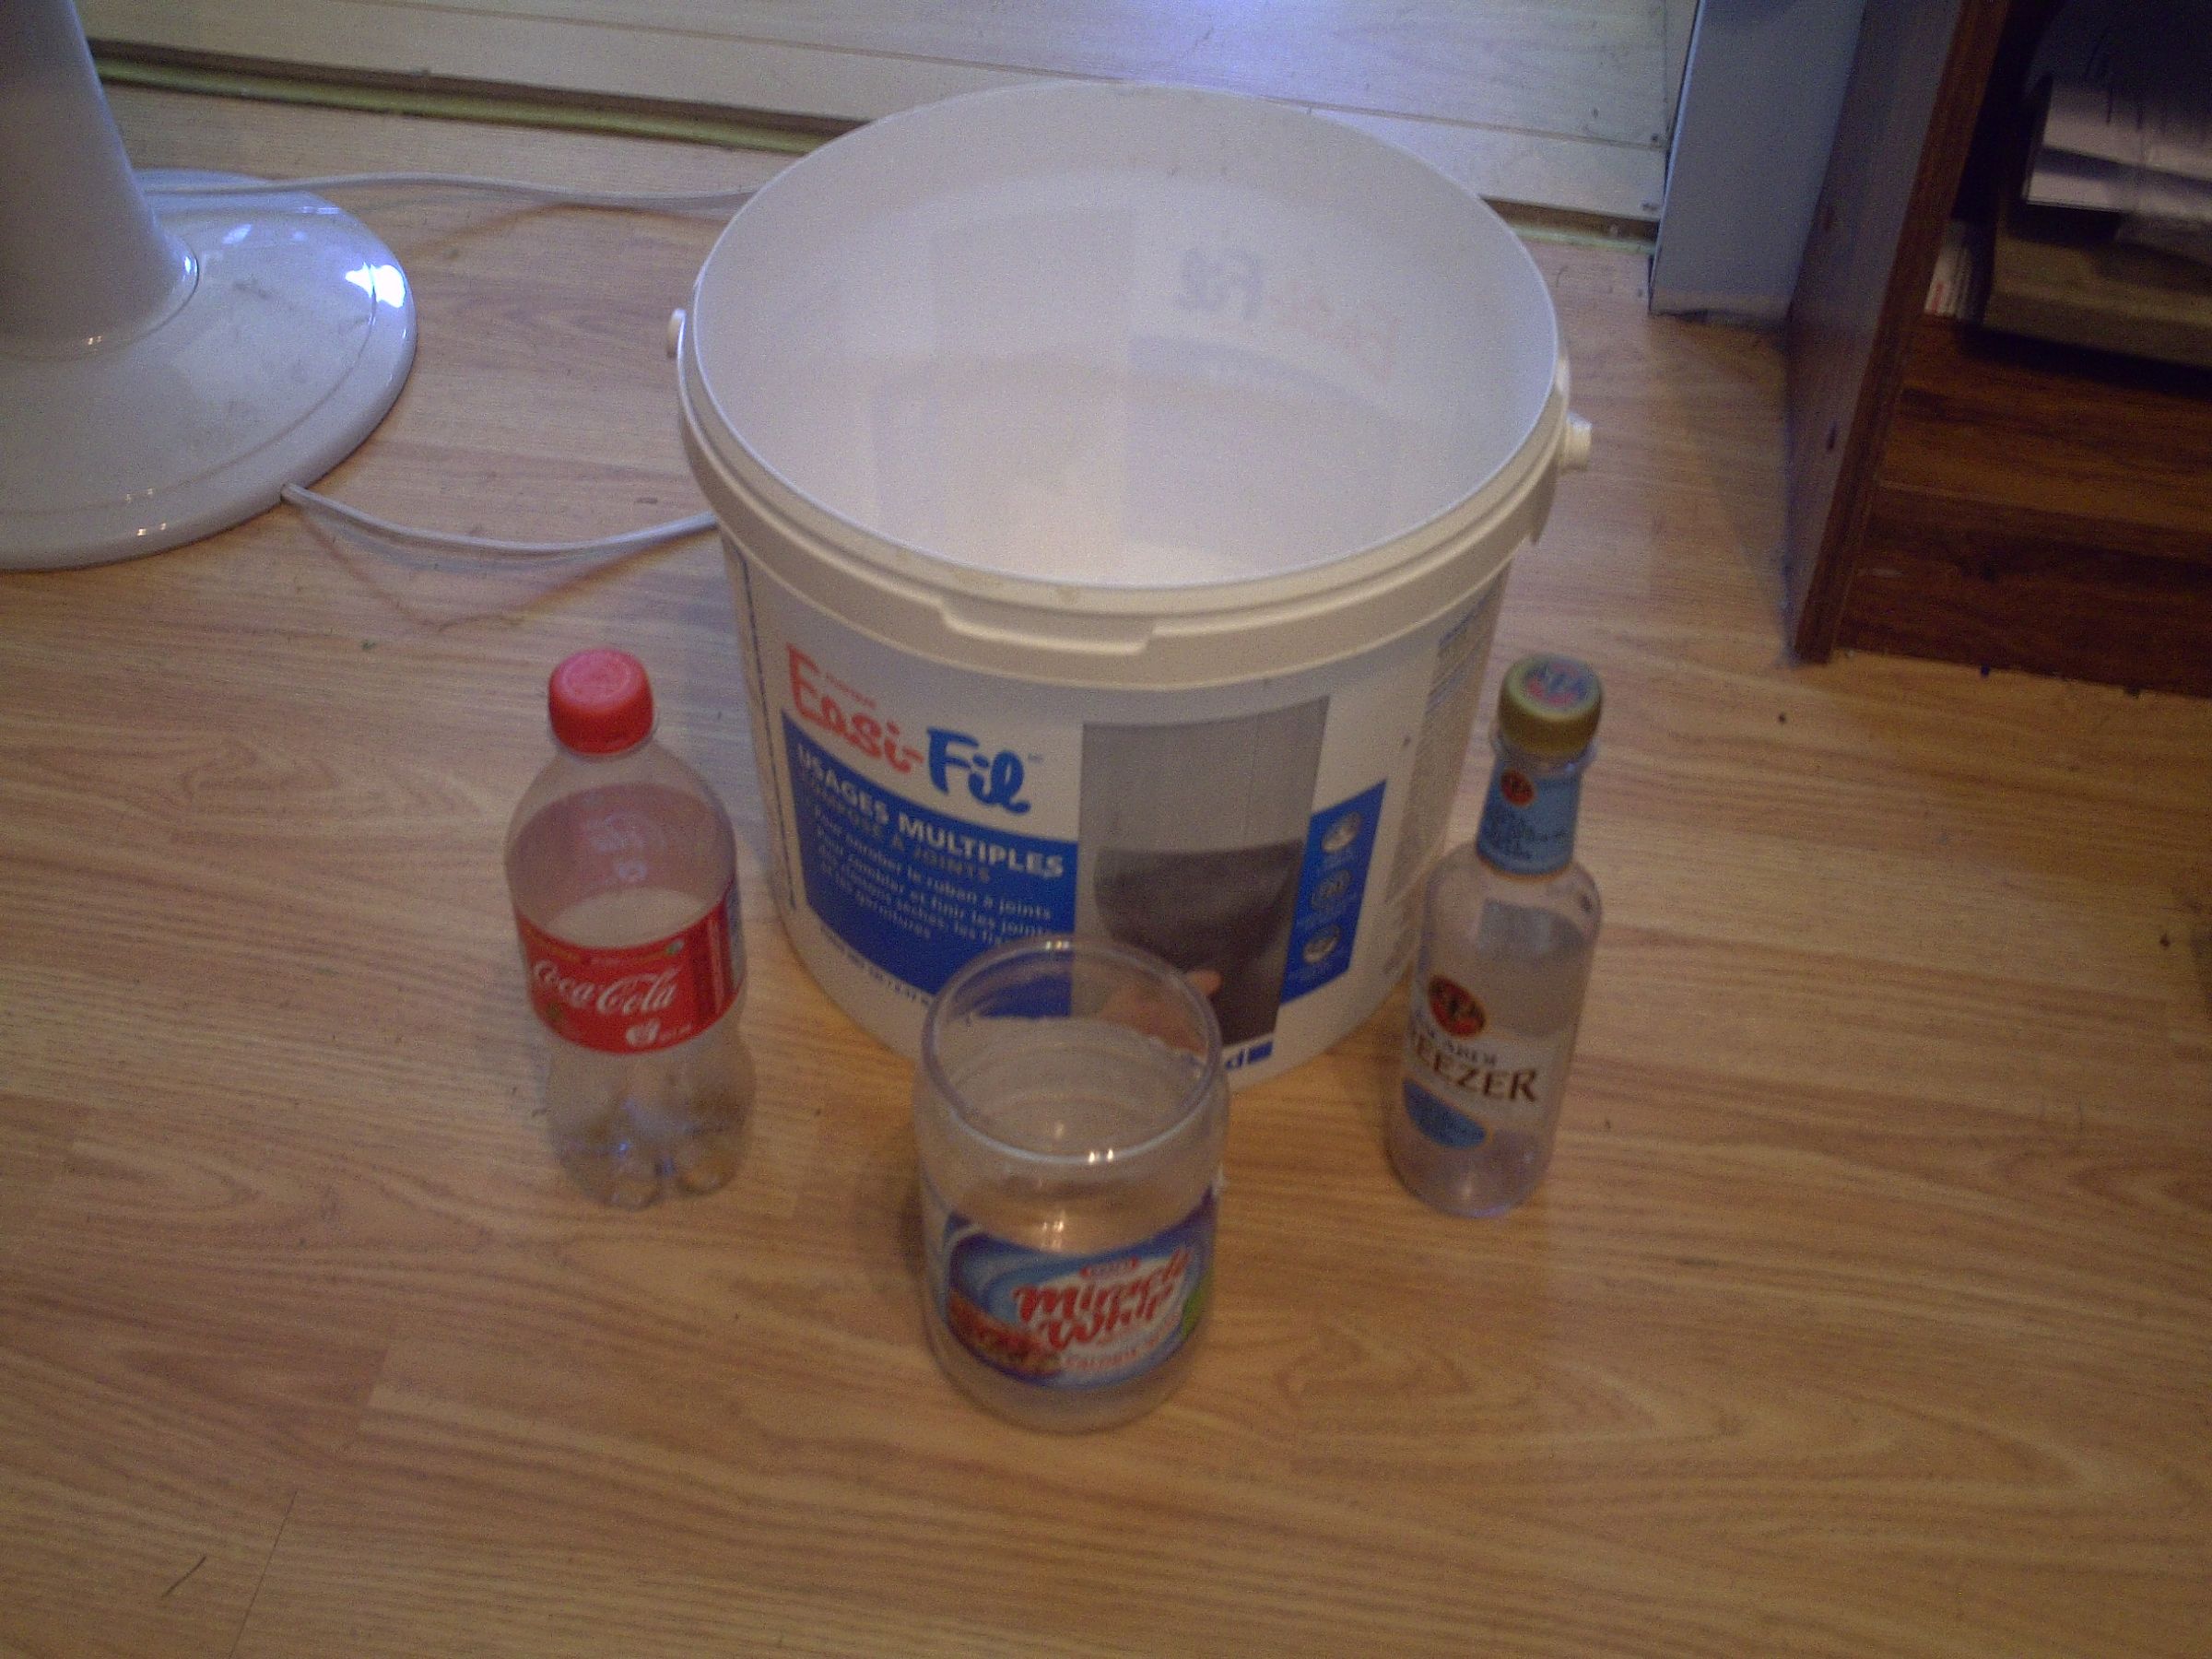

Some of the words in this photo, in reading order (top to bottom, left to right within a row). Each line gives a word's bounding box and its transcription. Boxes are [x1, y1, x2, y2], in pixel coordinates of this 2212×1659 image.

[796, 743, 888, 825] USAGES
[899, 812, 1063, 878] MULTIPLES
[998, 897, 1052, 922] joints
